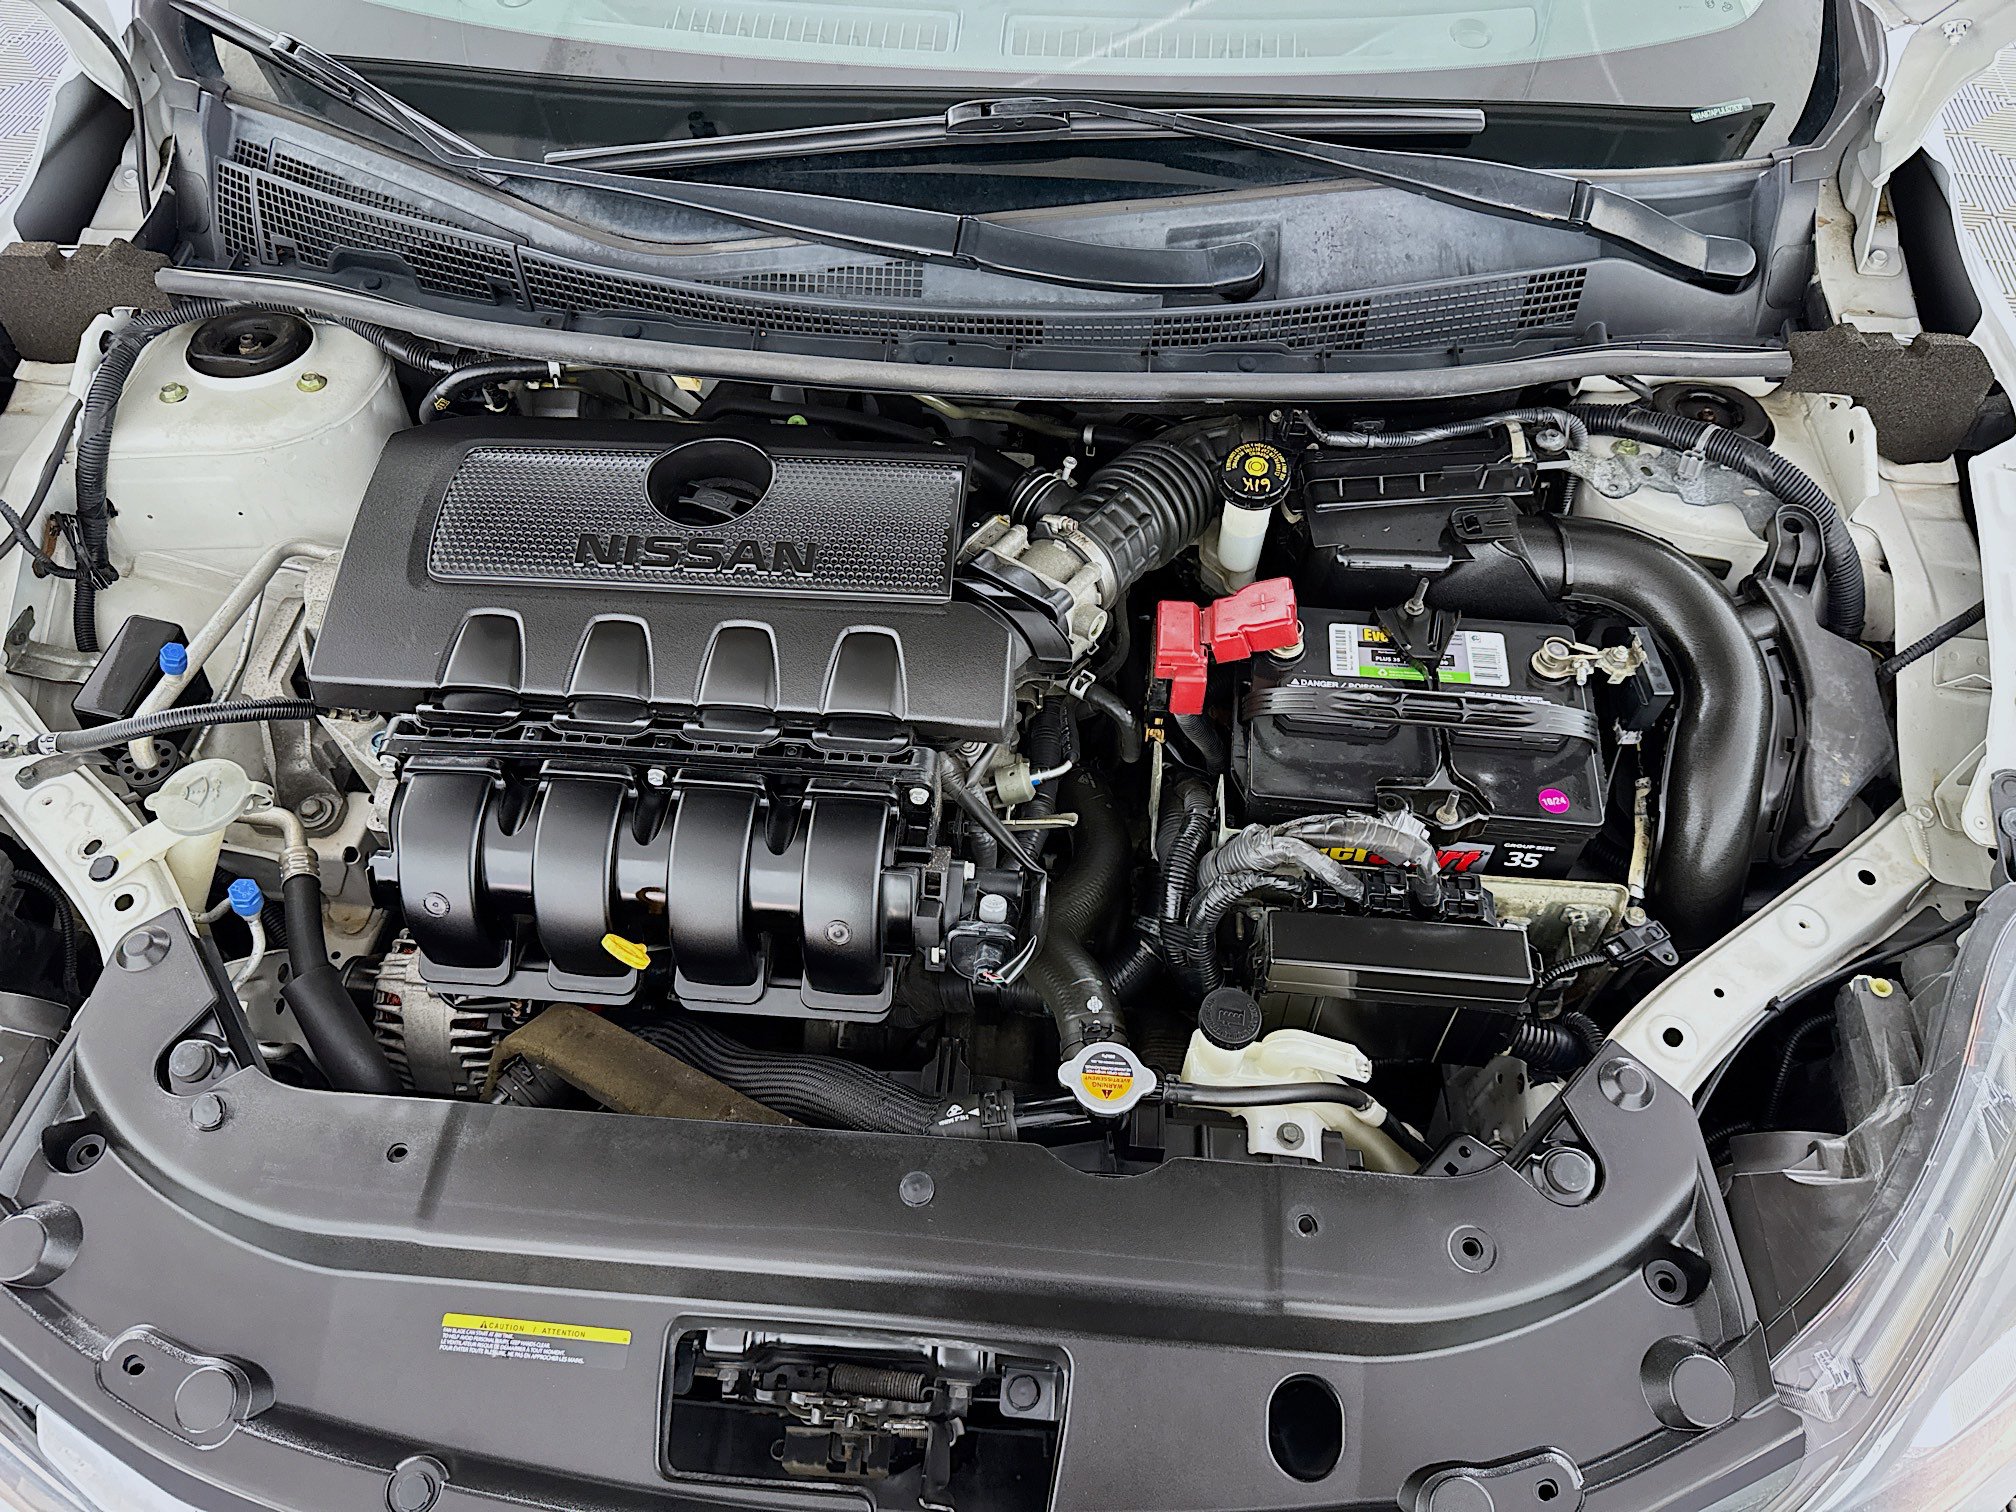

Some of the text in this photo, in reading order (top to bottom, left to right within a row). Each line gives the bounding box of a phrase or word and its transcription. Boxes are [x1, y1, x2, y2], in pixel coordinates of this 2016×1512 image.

[574, 533, 818, 576] NISSAN
[1301, 679, 1339, 688] DANGER
[1504, 851, 1543, 868] 35
[488, 1323, 524, 1331] CAUTION
[542, 1328, 586, 1337] ATTENTION
